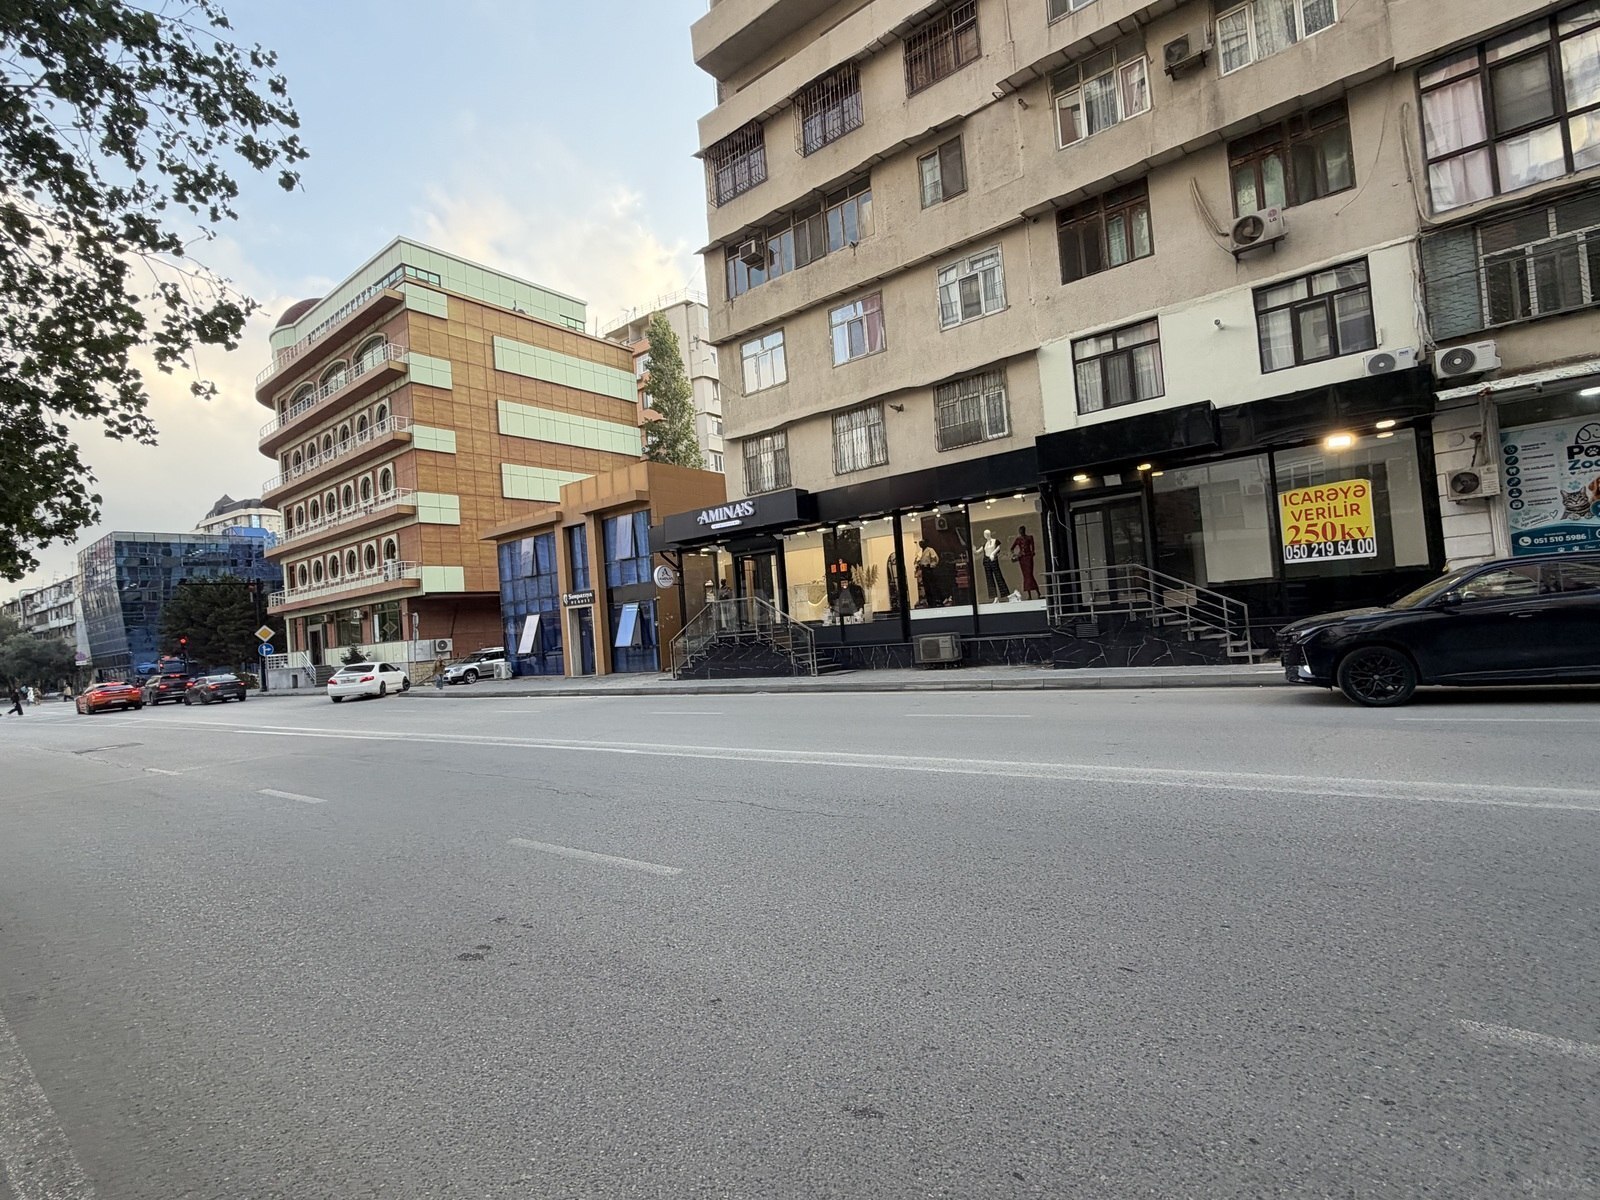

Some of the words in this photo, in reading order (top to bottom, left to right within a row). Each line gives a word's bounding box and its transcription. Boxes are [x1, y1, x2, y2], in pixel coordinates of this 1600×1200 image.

[1290, 501, 1362, 523] VERİLİR
[1287, 521, 1337, 545] 250
[1549, 535, 1564, 543] 510
[1565, 533, 1587, 541] 5986
[1285, 544, 1308, 560] 050
[1311, 541, 1335, 557] 219
[1338, 540, 1354, 555] 64
[1357, 538, 1374, 553] 00
